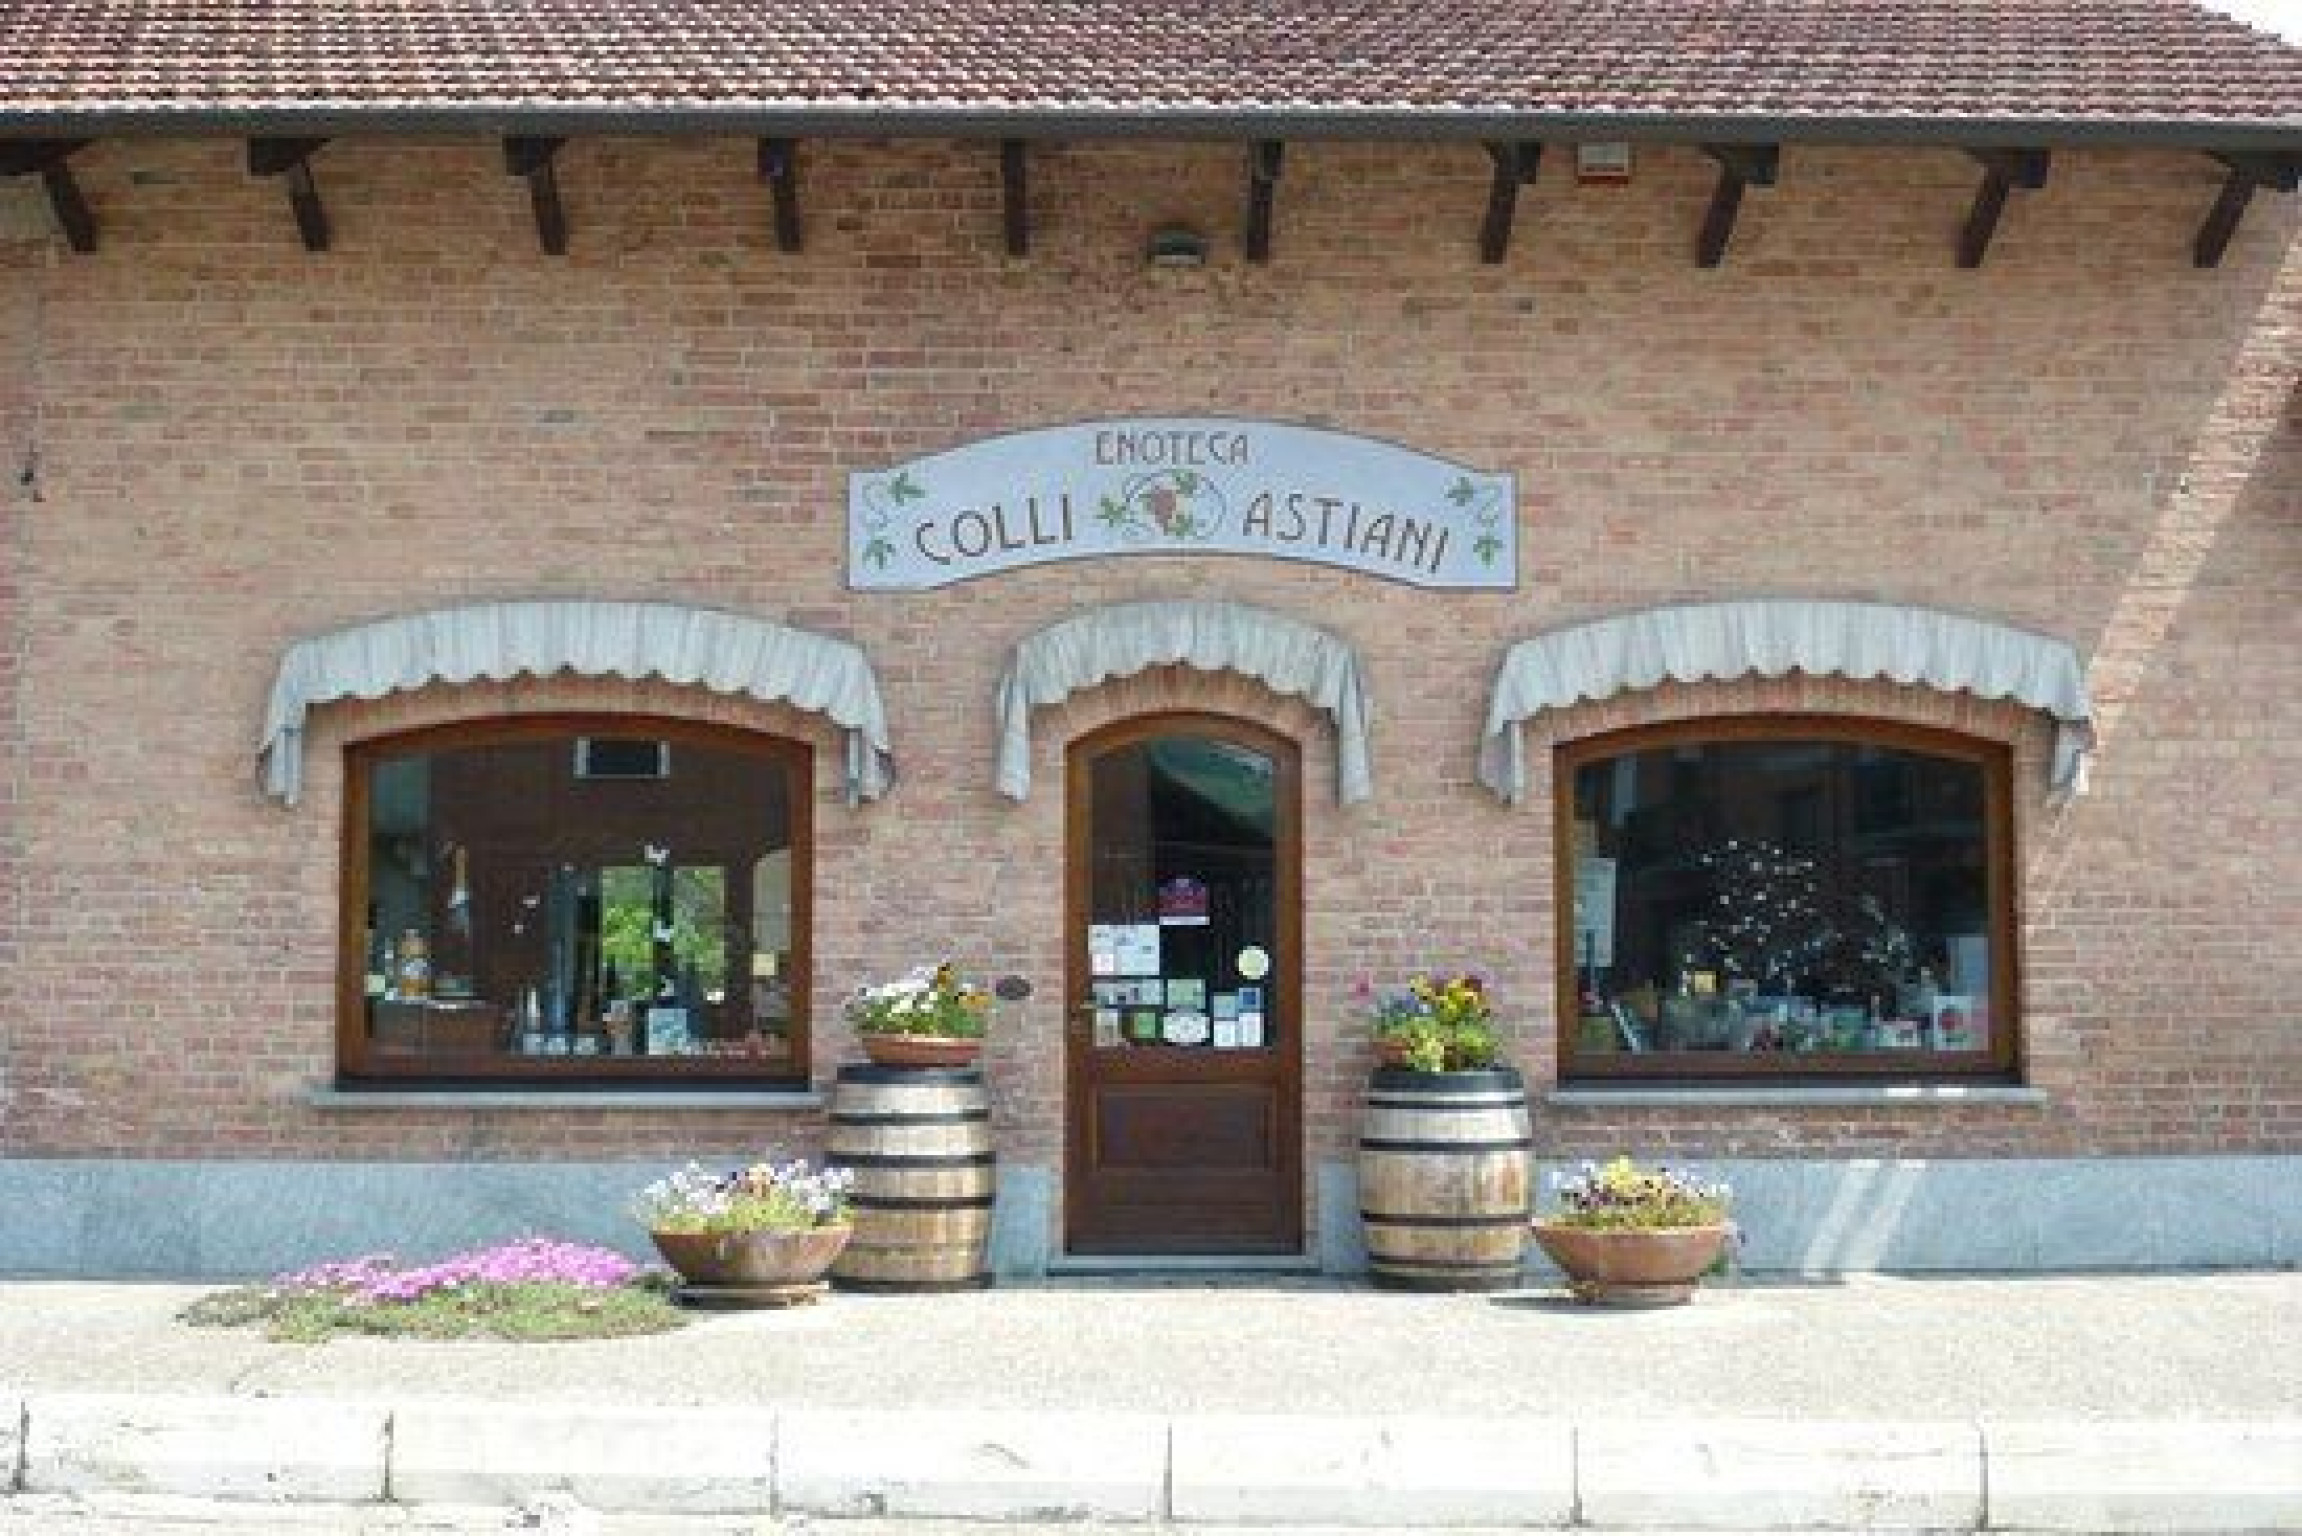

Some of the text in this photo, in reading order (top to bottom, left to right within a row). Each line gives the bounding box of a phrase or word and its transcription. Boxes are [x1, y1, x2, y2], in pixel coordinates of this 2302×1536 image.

[1096, 430, 1249, 465] ENOTECA
[916, 493, 1450, 573] COLLI ASTIANI
